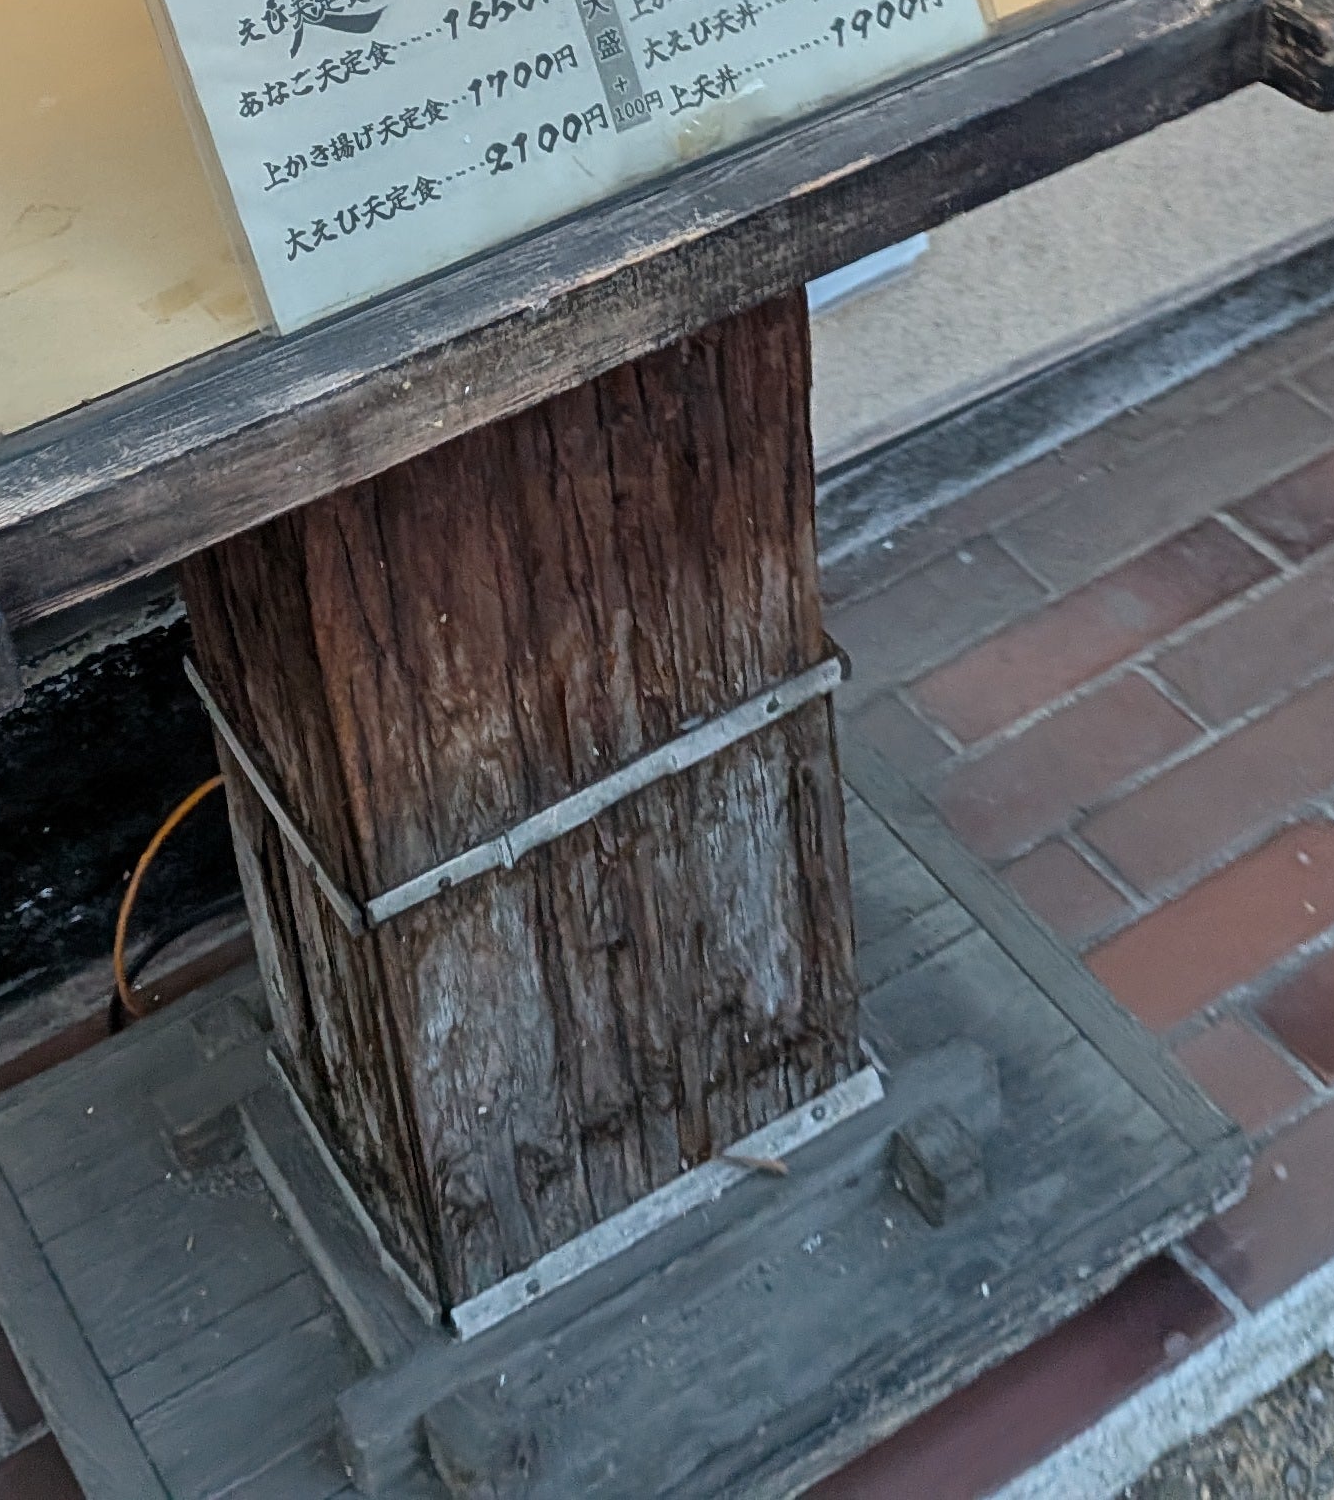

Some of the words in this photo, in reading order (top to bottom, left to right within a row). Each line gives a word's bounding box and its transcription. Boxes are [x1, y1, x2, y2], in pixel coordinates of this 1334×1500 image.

[643, 0, 759, 68] 大えび天丼
[263, 99, 449, 191] 上かき揚げ天定食
[468, 45, 578, 108] 1700円
[668, 64, 739, 116] 上天丼
[285, 175, 443, 261] 大えび天定食
[486, 103, 611, 175] 2100円
